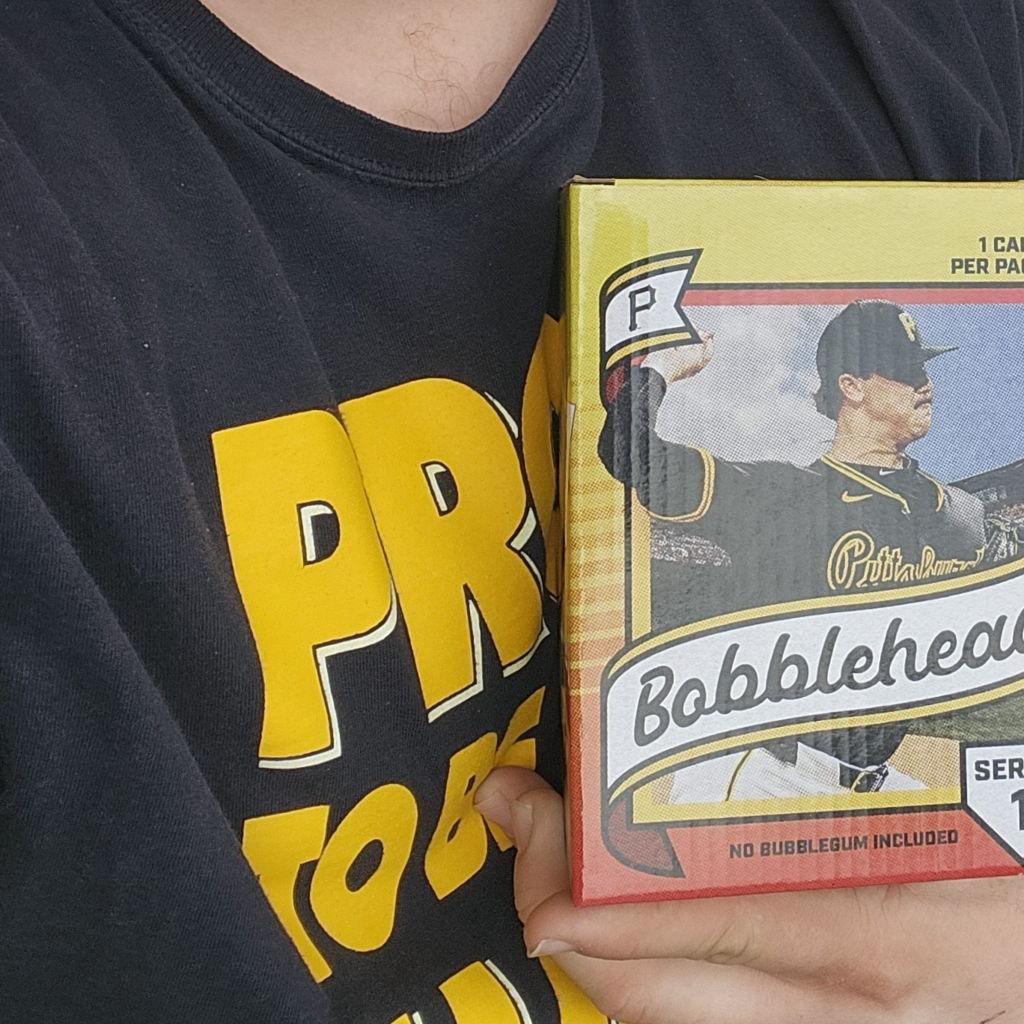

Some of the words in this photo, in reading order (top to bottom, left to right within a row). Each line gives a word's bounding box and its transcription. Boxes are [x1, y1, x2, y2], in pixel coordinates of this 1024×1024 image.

[979, 236, 987, 253] 1
[951, 257, 989, 275] PER
[628, 284, 658, 332] P
[729, 843, 755, 858] NO
[760, 835, 869, 857] BUBBLEGUM
[873, 829, 959, 850] INCLUDED
[242, 783, 418, 984] TO
